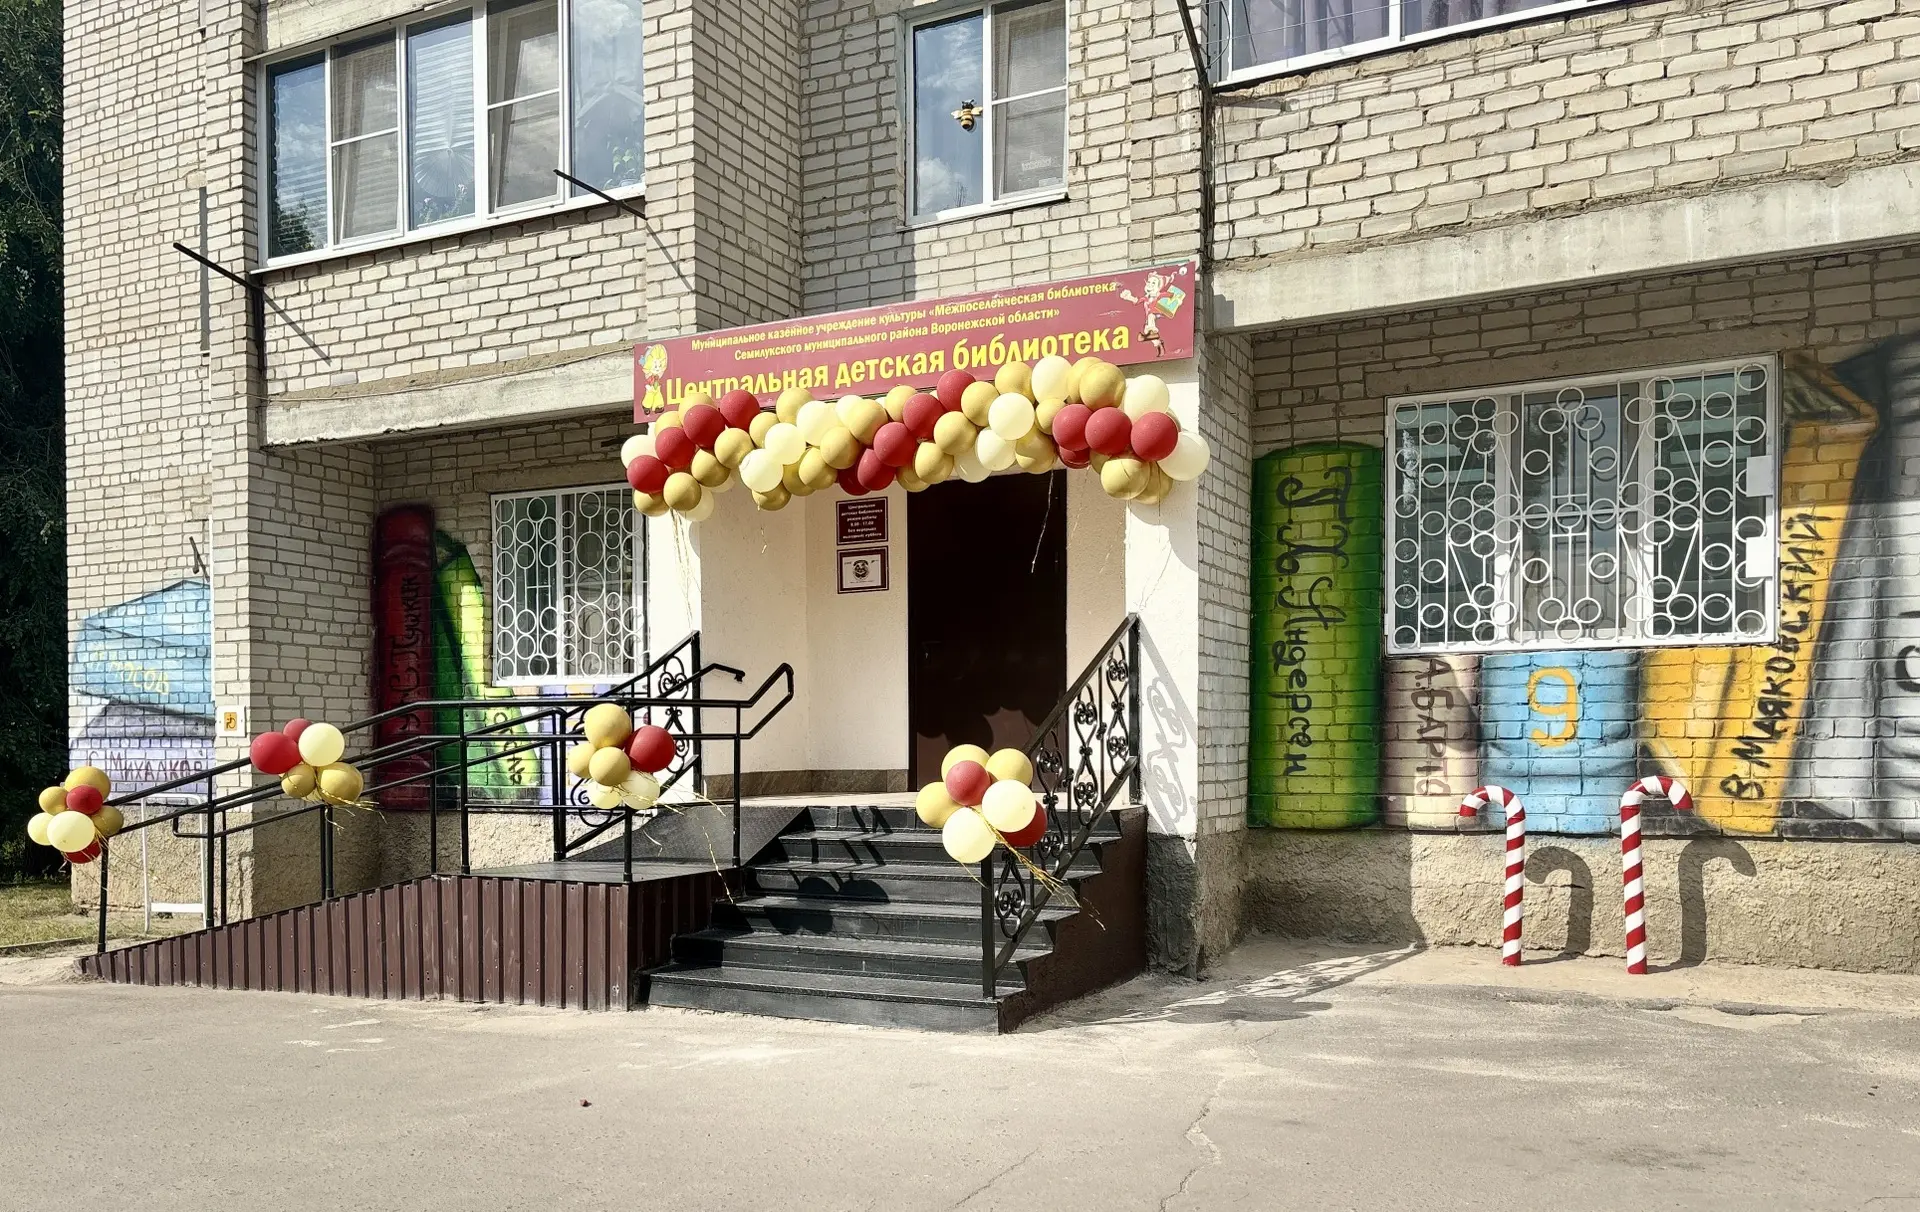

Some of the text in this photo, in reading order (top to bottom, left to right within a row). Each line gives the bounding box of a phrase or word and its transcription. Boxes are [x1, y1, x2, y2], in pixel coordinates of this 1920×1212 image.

[691, 280, 1117, 351] Муниципальное казённое учреждение культуры «Межпоселенческая библиотека
[734, 307, 1060, 361] Семилукского муниципального района Воронежской области»
[666, 325, 1129, 405] Центральная детская библиотека
